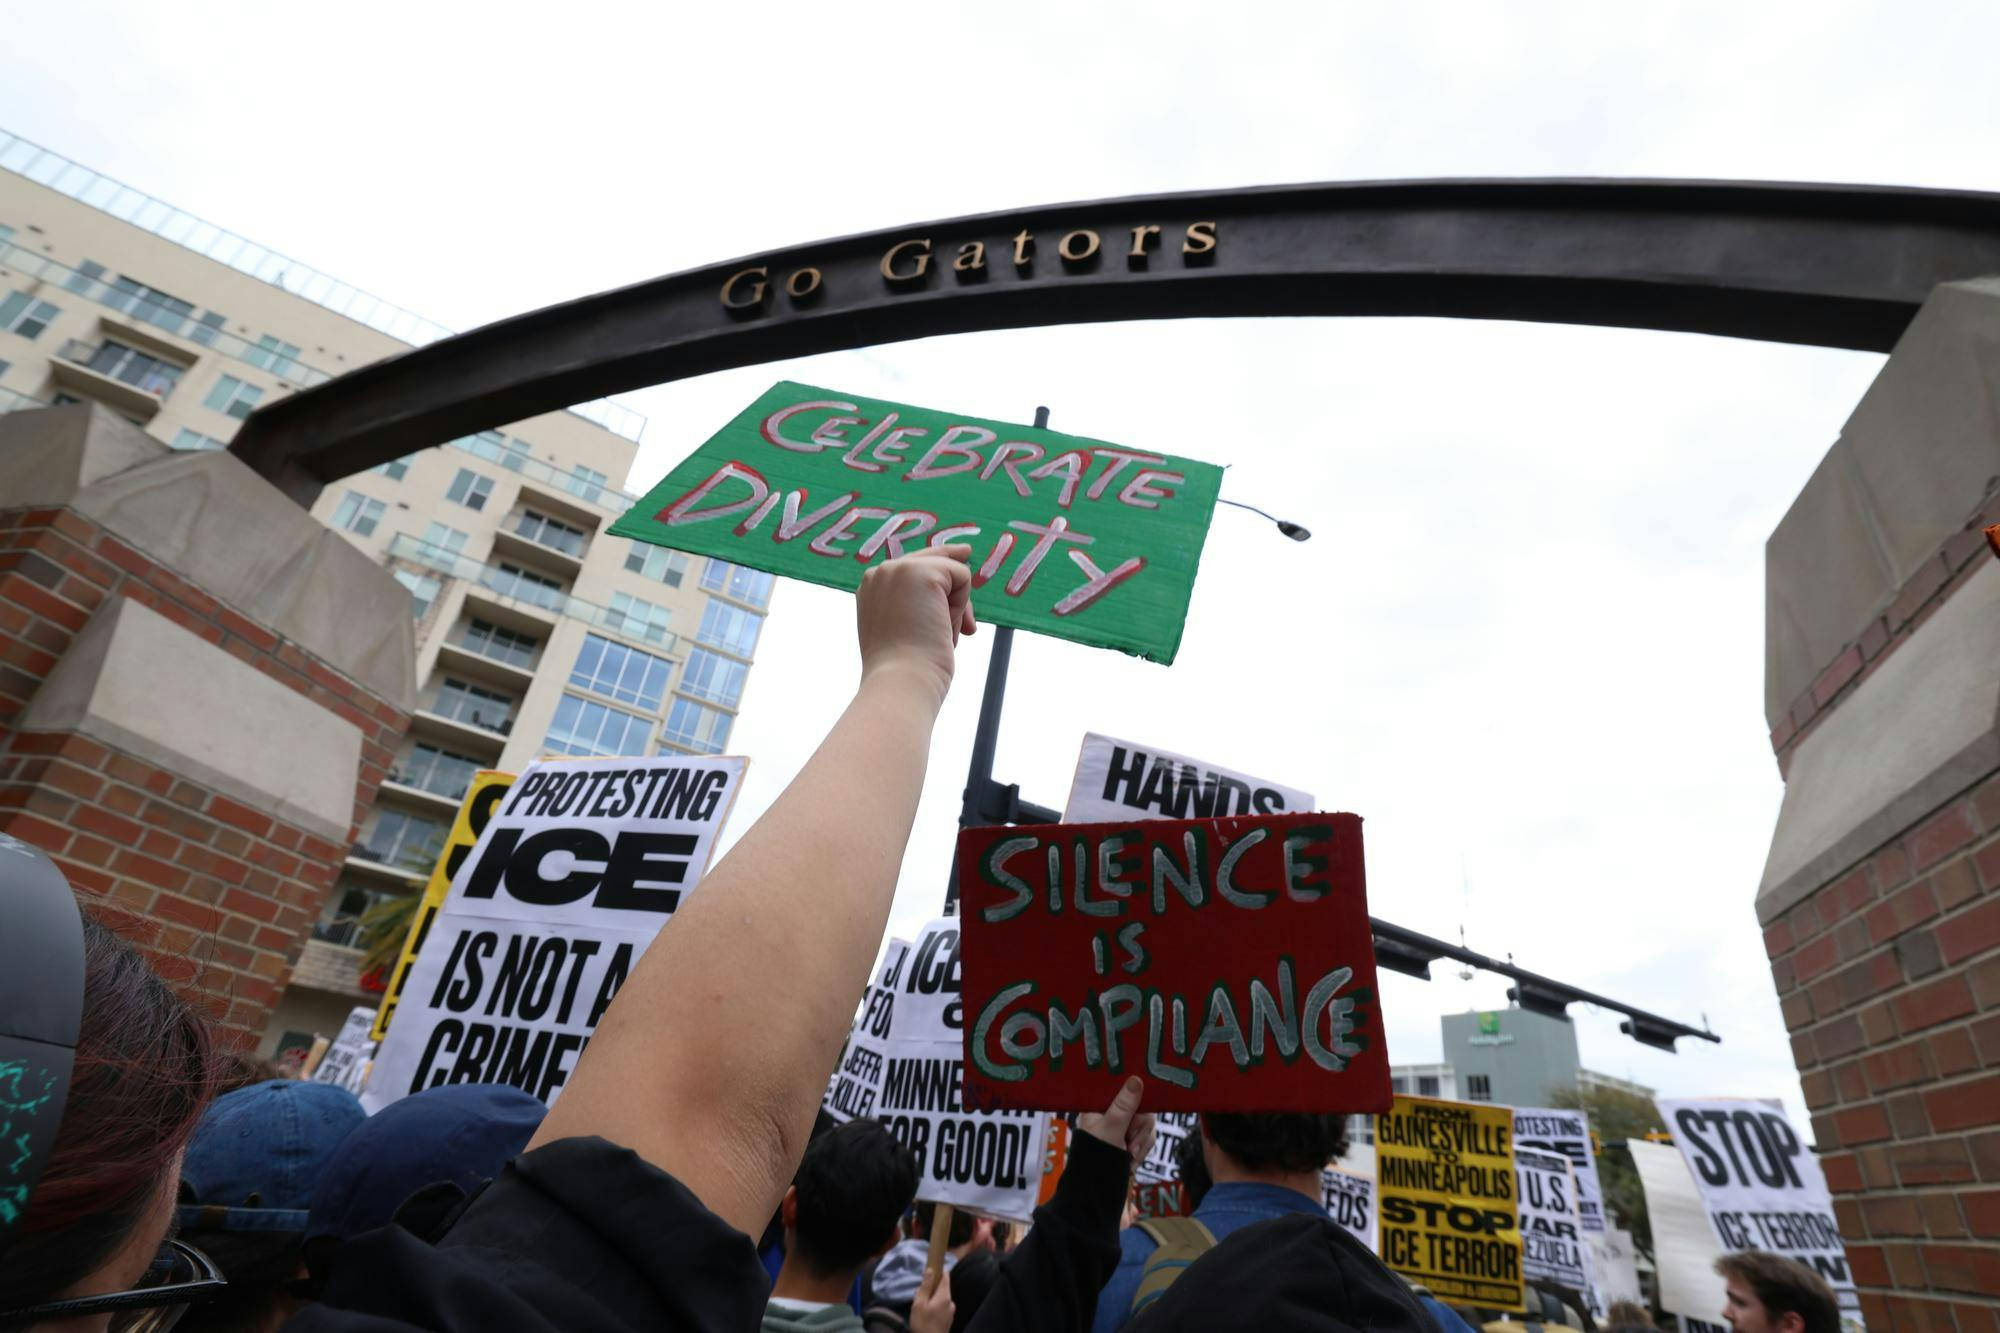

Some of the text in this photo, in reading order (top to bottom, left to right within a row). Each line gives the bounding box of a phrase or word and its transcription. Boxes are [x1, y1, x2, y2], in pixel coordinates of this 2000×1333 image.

[720, 220, 1216, 309] Go Gators
[760, 401, 1185, 508] CELEBRATE
[505, 768, 729, 822] PROTESTING
[463, 827, 699, 914] ICE
[981, 826, 1333, 922] SILENCE
[1092, 921, 1146, 974] IS
[428, 930, 498, 1013] IS
[484, 933, 602, 1025] NOT
[860, 988, 894, 1040] FO
[972, 956, 1371, 1088] COMPLIANCE
[844, 1045, 883, 1085] JEFFR
[1378, 1114, 1509, 1158] GAINESVILLE
[1414, 1105, 1471, 1121] FROM
[1512, 1117, 1583, 1136] OTESTING
[933, 1119, 1032, 1190] GOOD!
[1432, 1151, 1458, 1163] TO
[1675, 1108, 1804, 1189] STOP
[1380, 1156, 1511, 1200] MINNEAPOLIS
[1528, 1171, 1574, 1216] U.S.
[1382, 1197, 1514, 1235] STOP
[1711, 1211, 1842, 1250] ICE TERROR
[1383, 1228, 1420, 1268] ICE
[1425, 1233, 1519, 1282] TERROR
[1521, 1236, 1583, 1270] EZUELA
